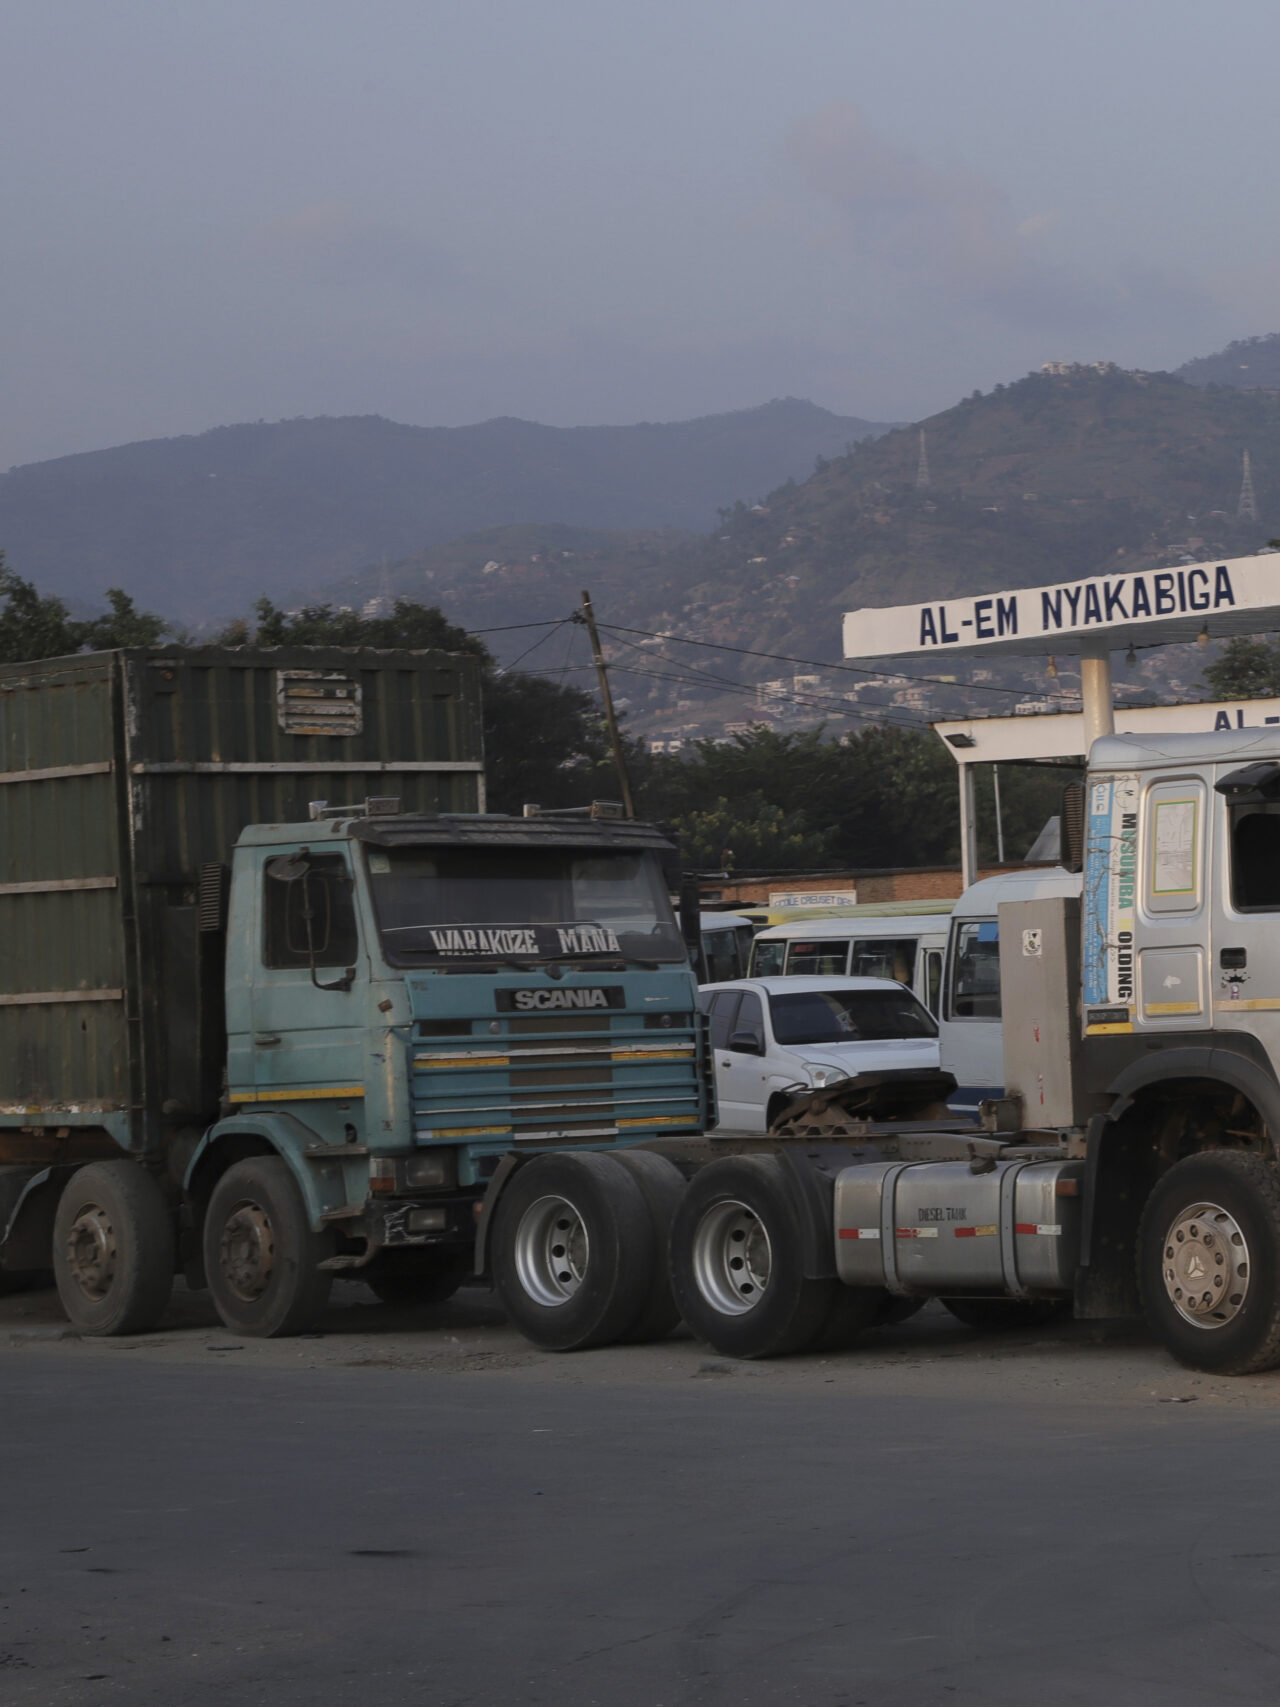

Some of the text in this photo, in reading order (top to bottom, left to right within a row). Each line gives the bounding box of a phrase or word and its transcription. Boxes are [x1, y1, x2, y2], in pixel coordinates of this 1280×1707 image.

[919, 565, 1236, 646] AL-EM NYAKABIGA
[1118, 813, 1137, 910] MUSUMBA
[429, 928, 622, 956] WARAKOZE MANA
[514, 988, 609, 1010] SCANIA
[918, 1207, 945, 1222] DIESEL
